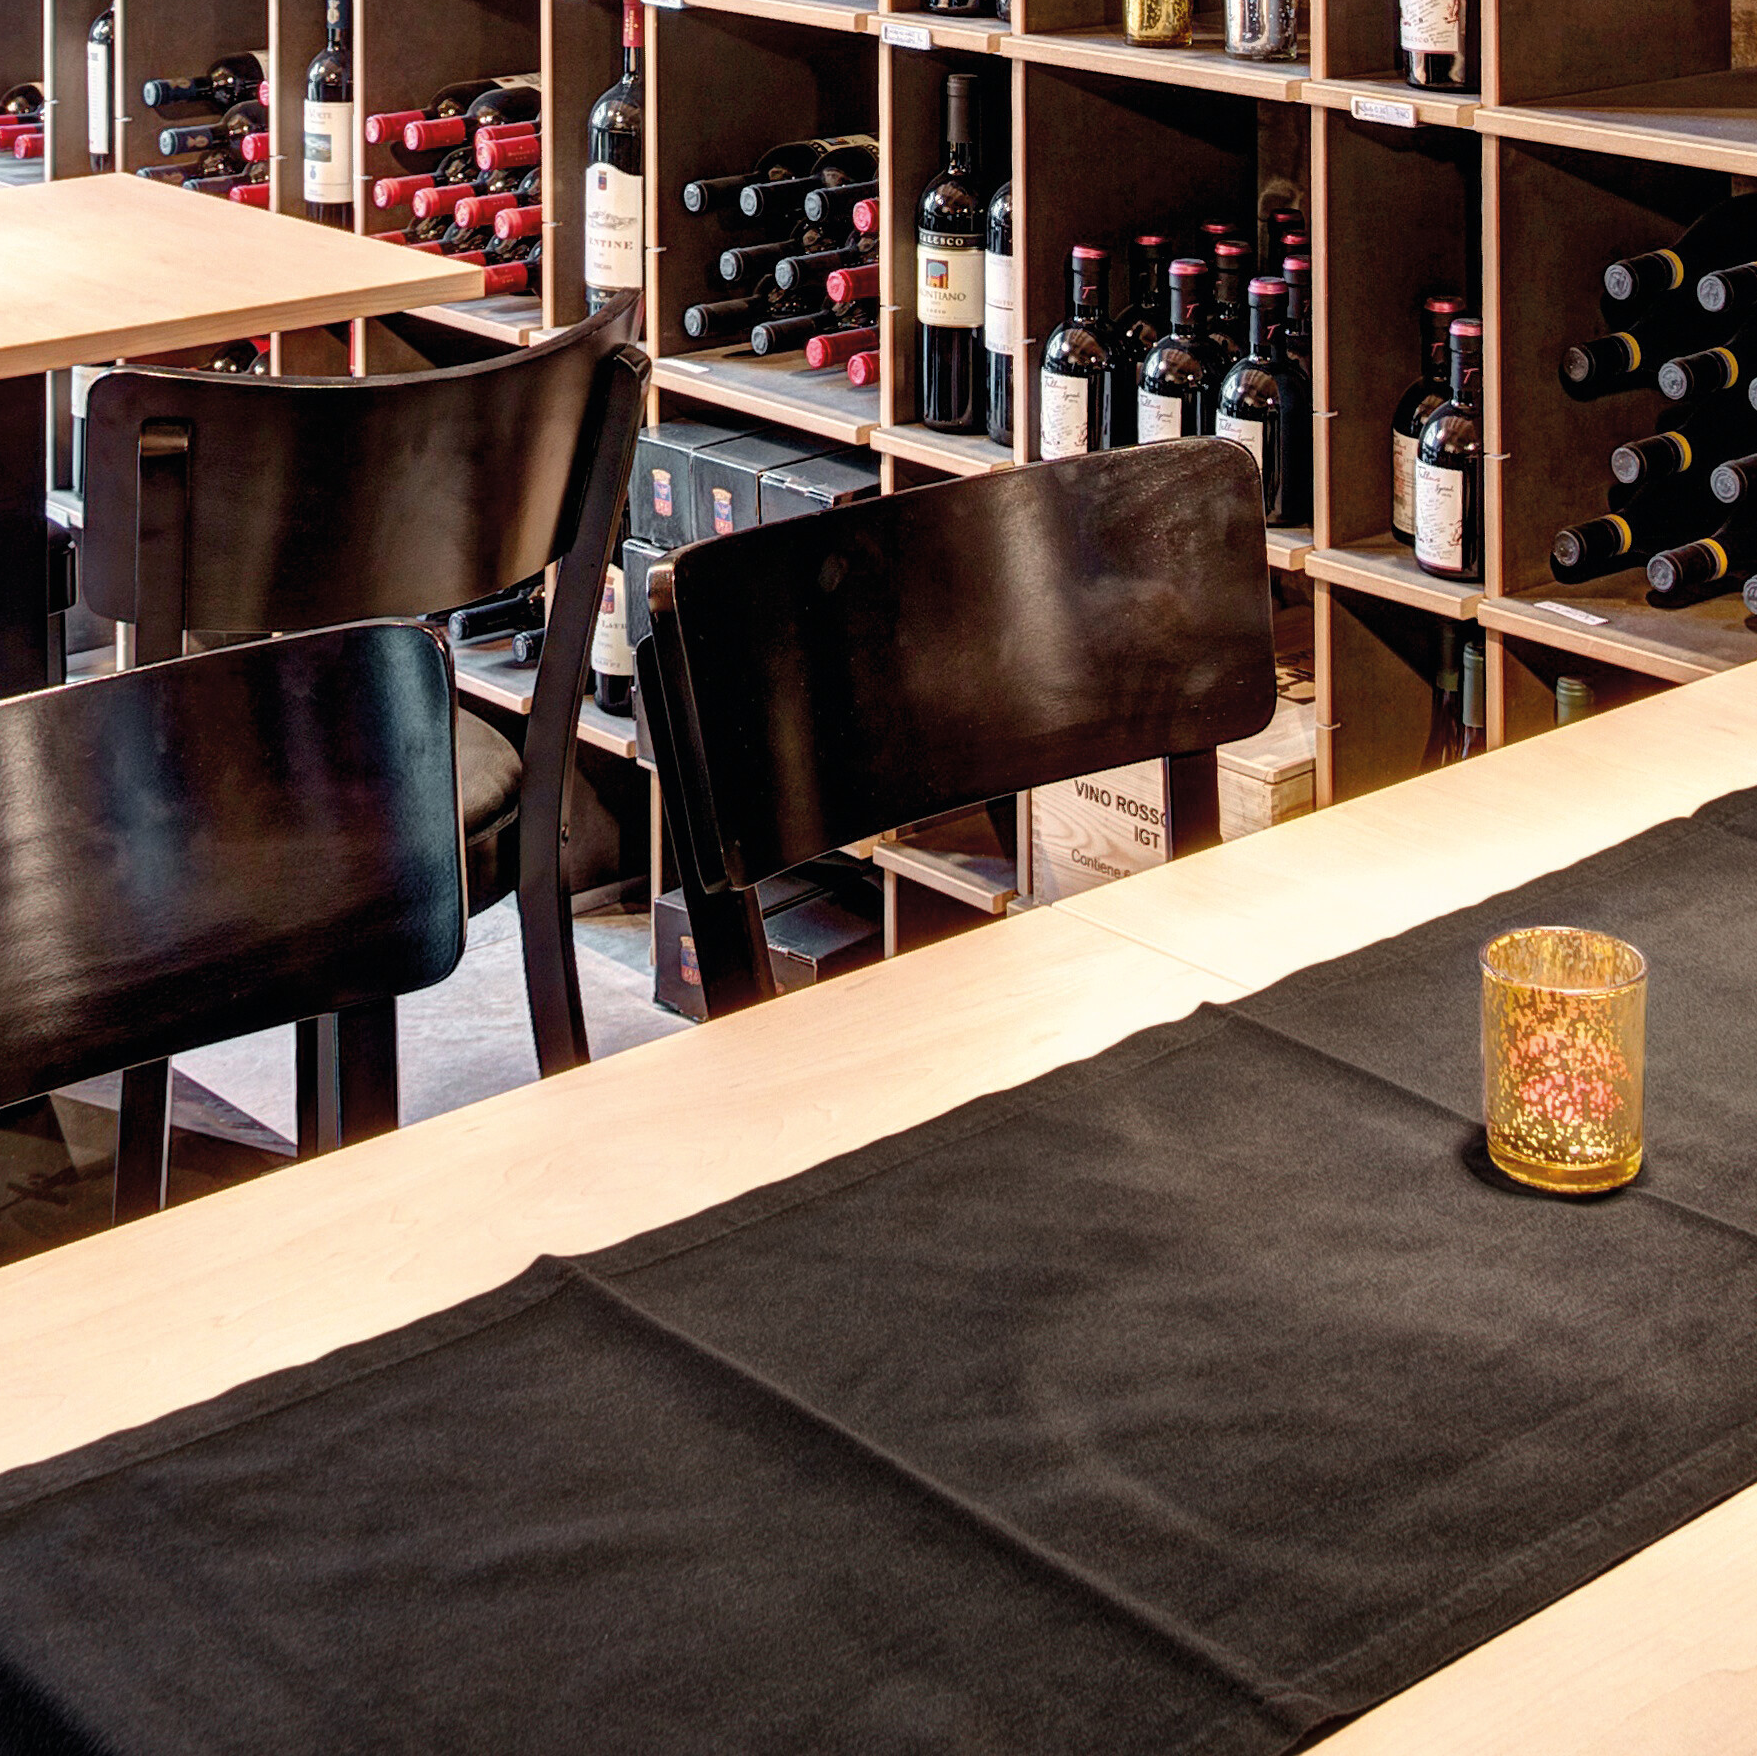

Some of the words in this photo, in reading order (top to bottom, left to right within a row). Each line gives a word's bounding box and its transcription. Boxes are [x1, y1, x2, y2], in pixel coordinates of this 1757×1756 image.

[918, 289, 967, 304] ONTIANO
[1073, 778, 1112, 806] VINO
[1133, 828, 1161, 849] IGT
[1070, 847, 1121, 880] Contiene
